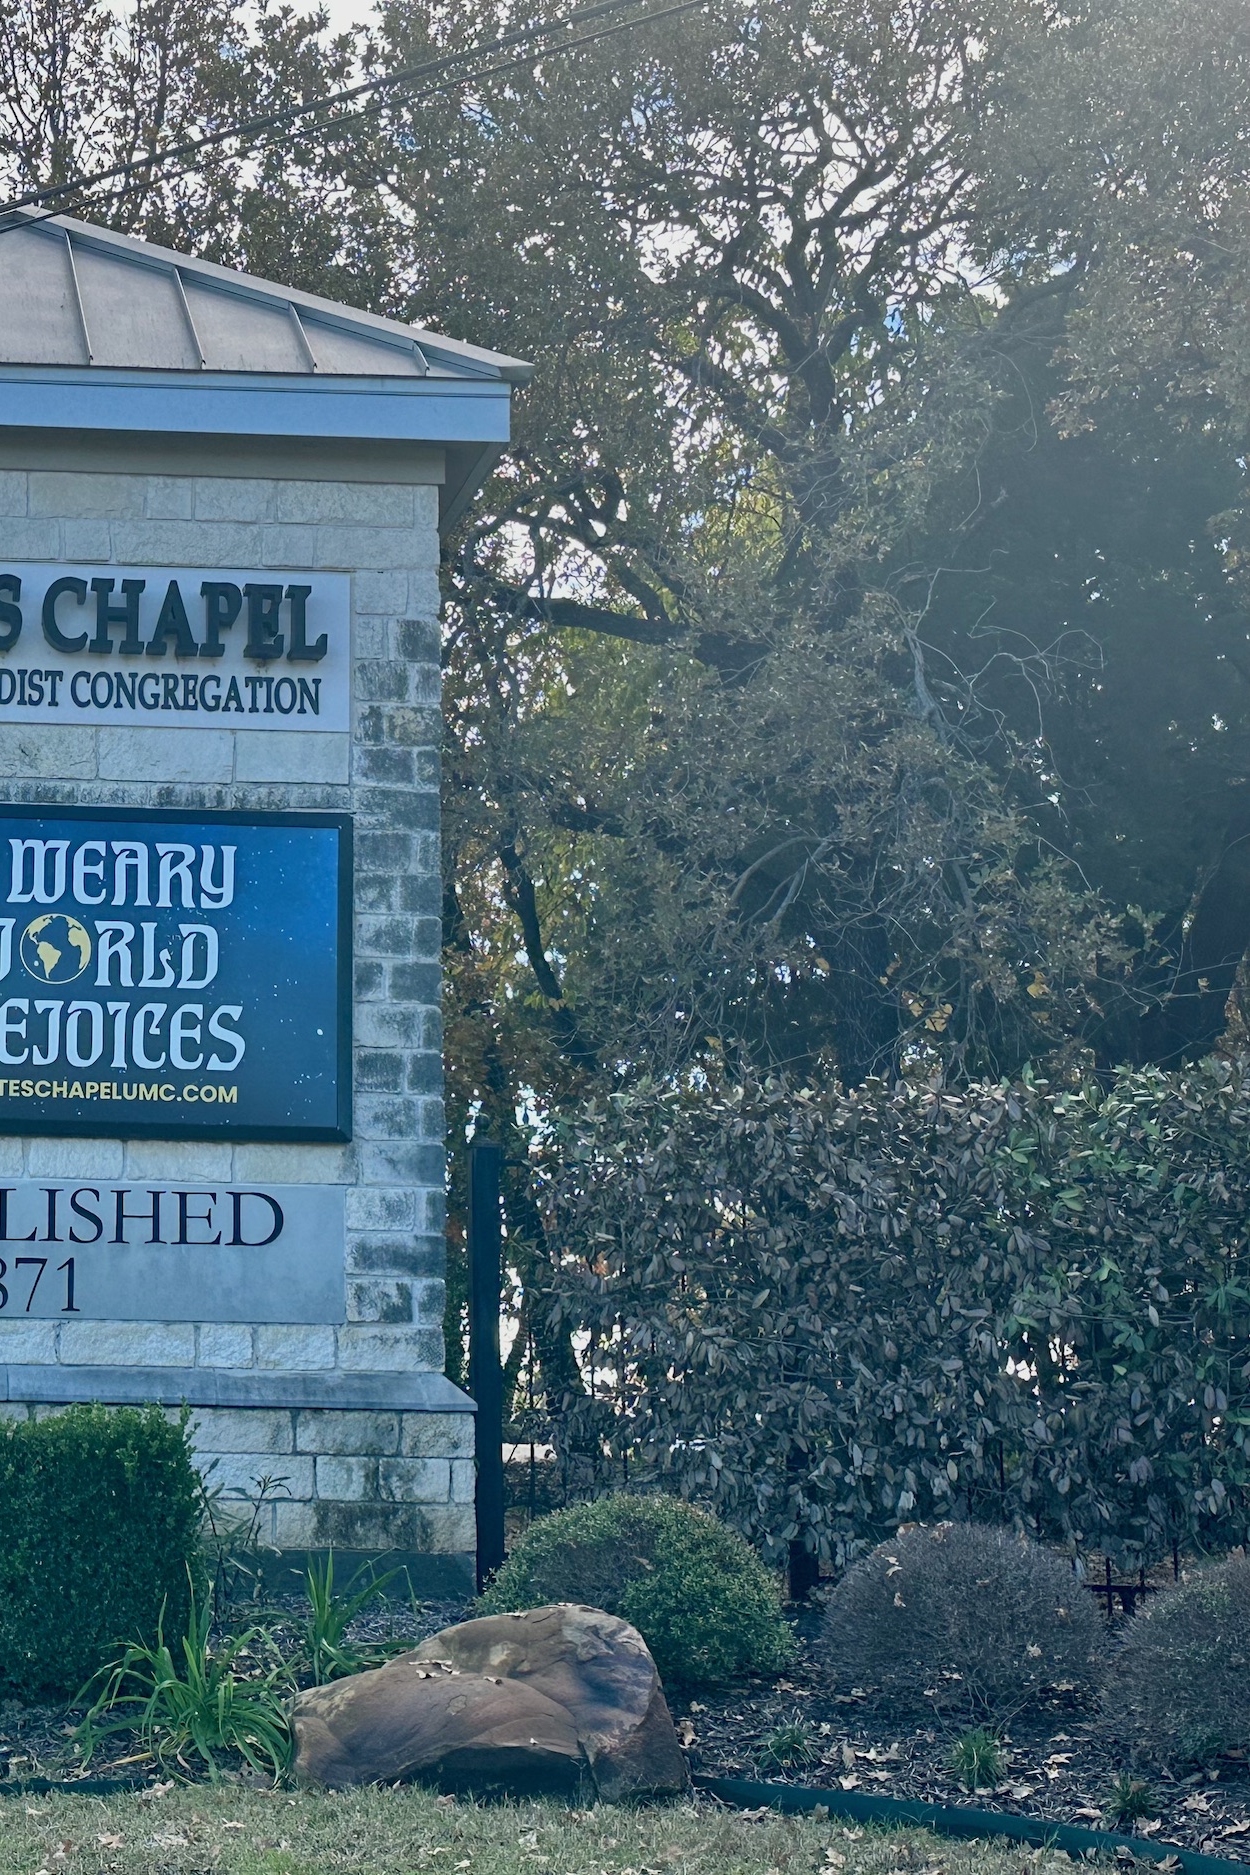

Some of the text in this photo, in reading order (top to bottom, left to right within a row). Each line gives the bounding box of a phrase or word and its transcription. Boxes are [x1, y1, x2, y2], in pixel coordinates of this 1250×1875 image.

[42, 576, 328, 661] CHAPEL
[71, 671, 322, 715] CONGREGATION
[7, 838, 237, 909] WEARY
